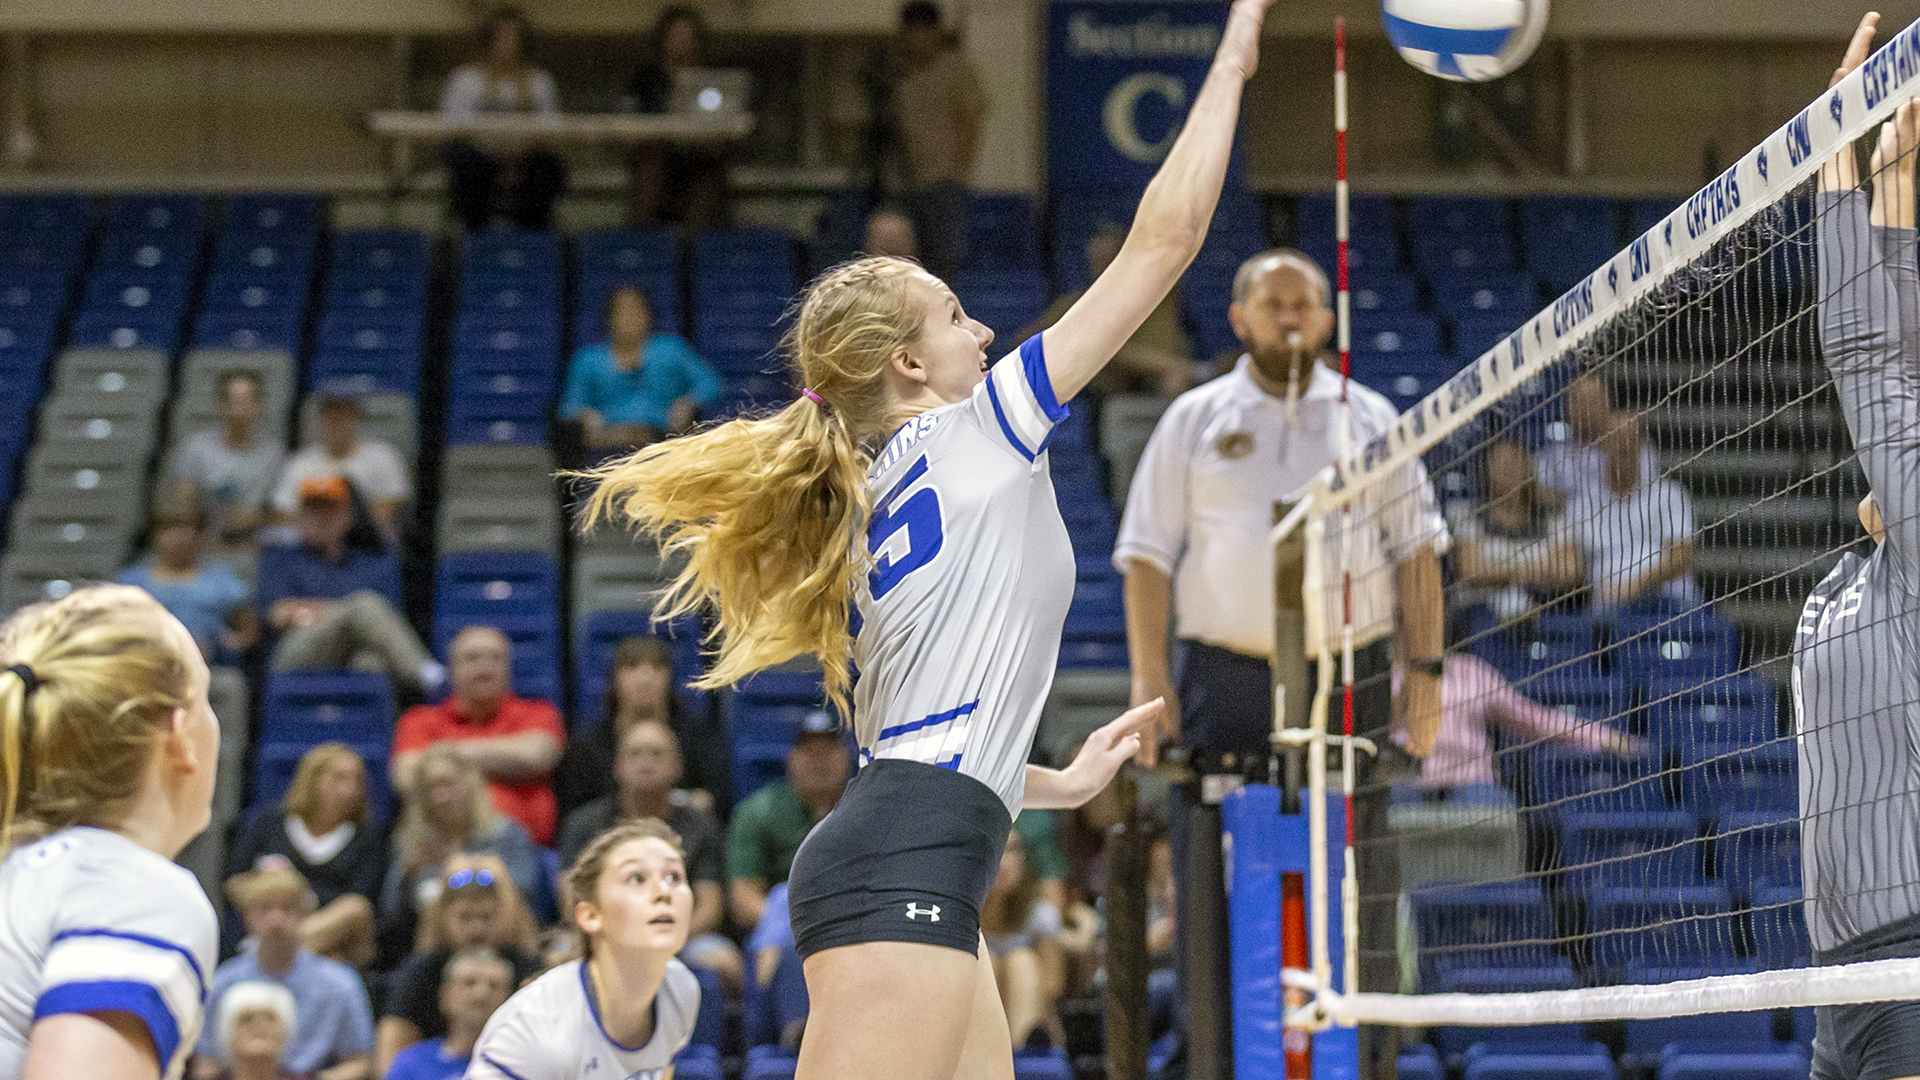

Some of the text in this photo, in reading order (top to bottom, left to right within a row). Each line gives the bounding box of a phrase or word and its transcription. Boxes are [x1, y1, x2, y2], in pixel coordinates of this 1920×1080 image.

[1103, 71, 1187, 163] C
[1786, 108, 1811, 168] CNU
[866, 450, 946, 602] 5
